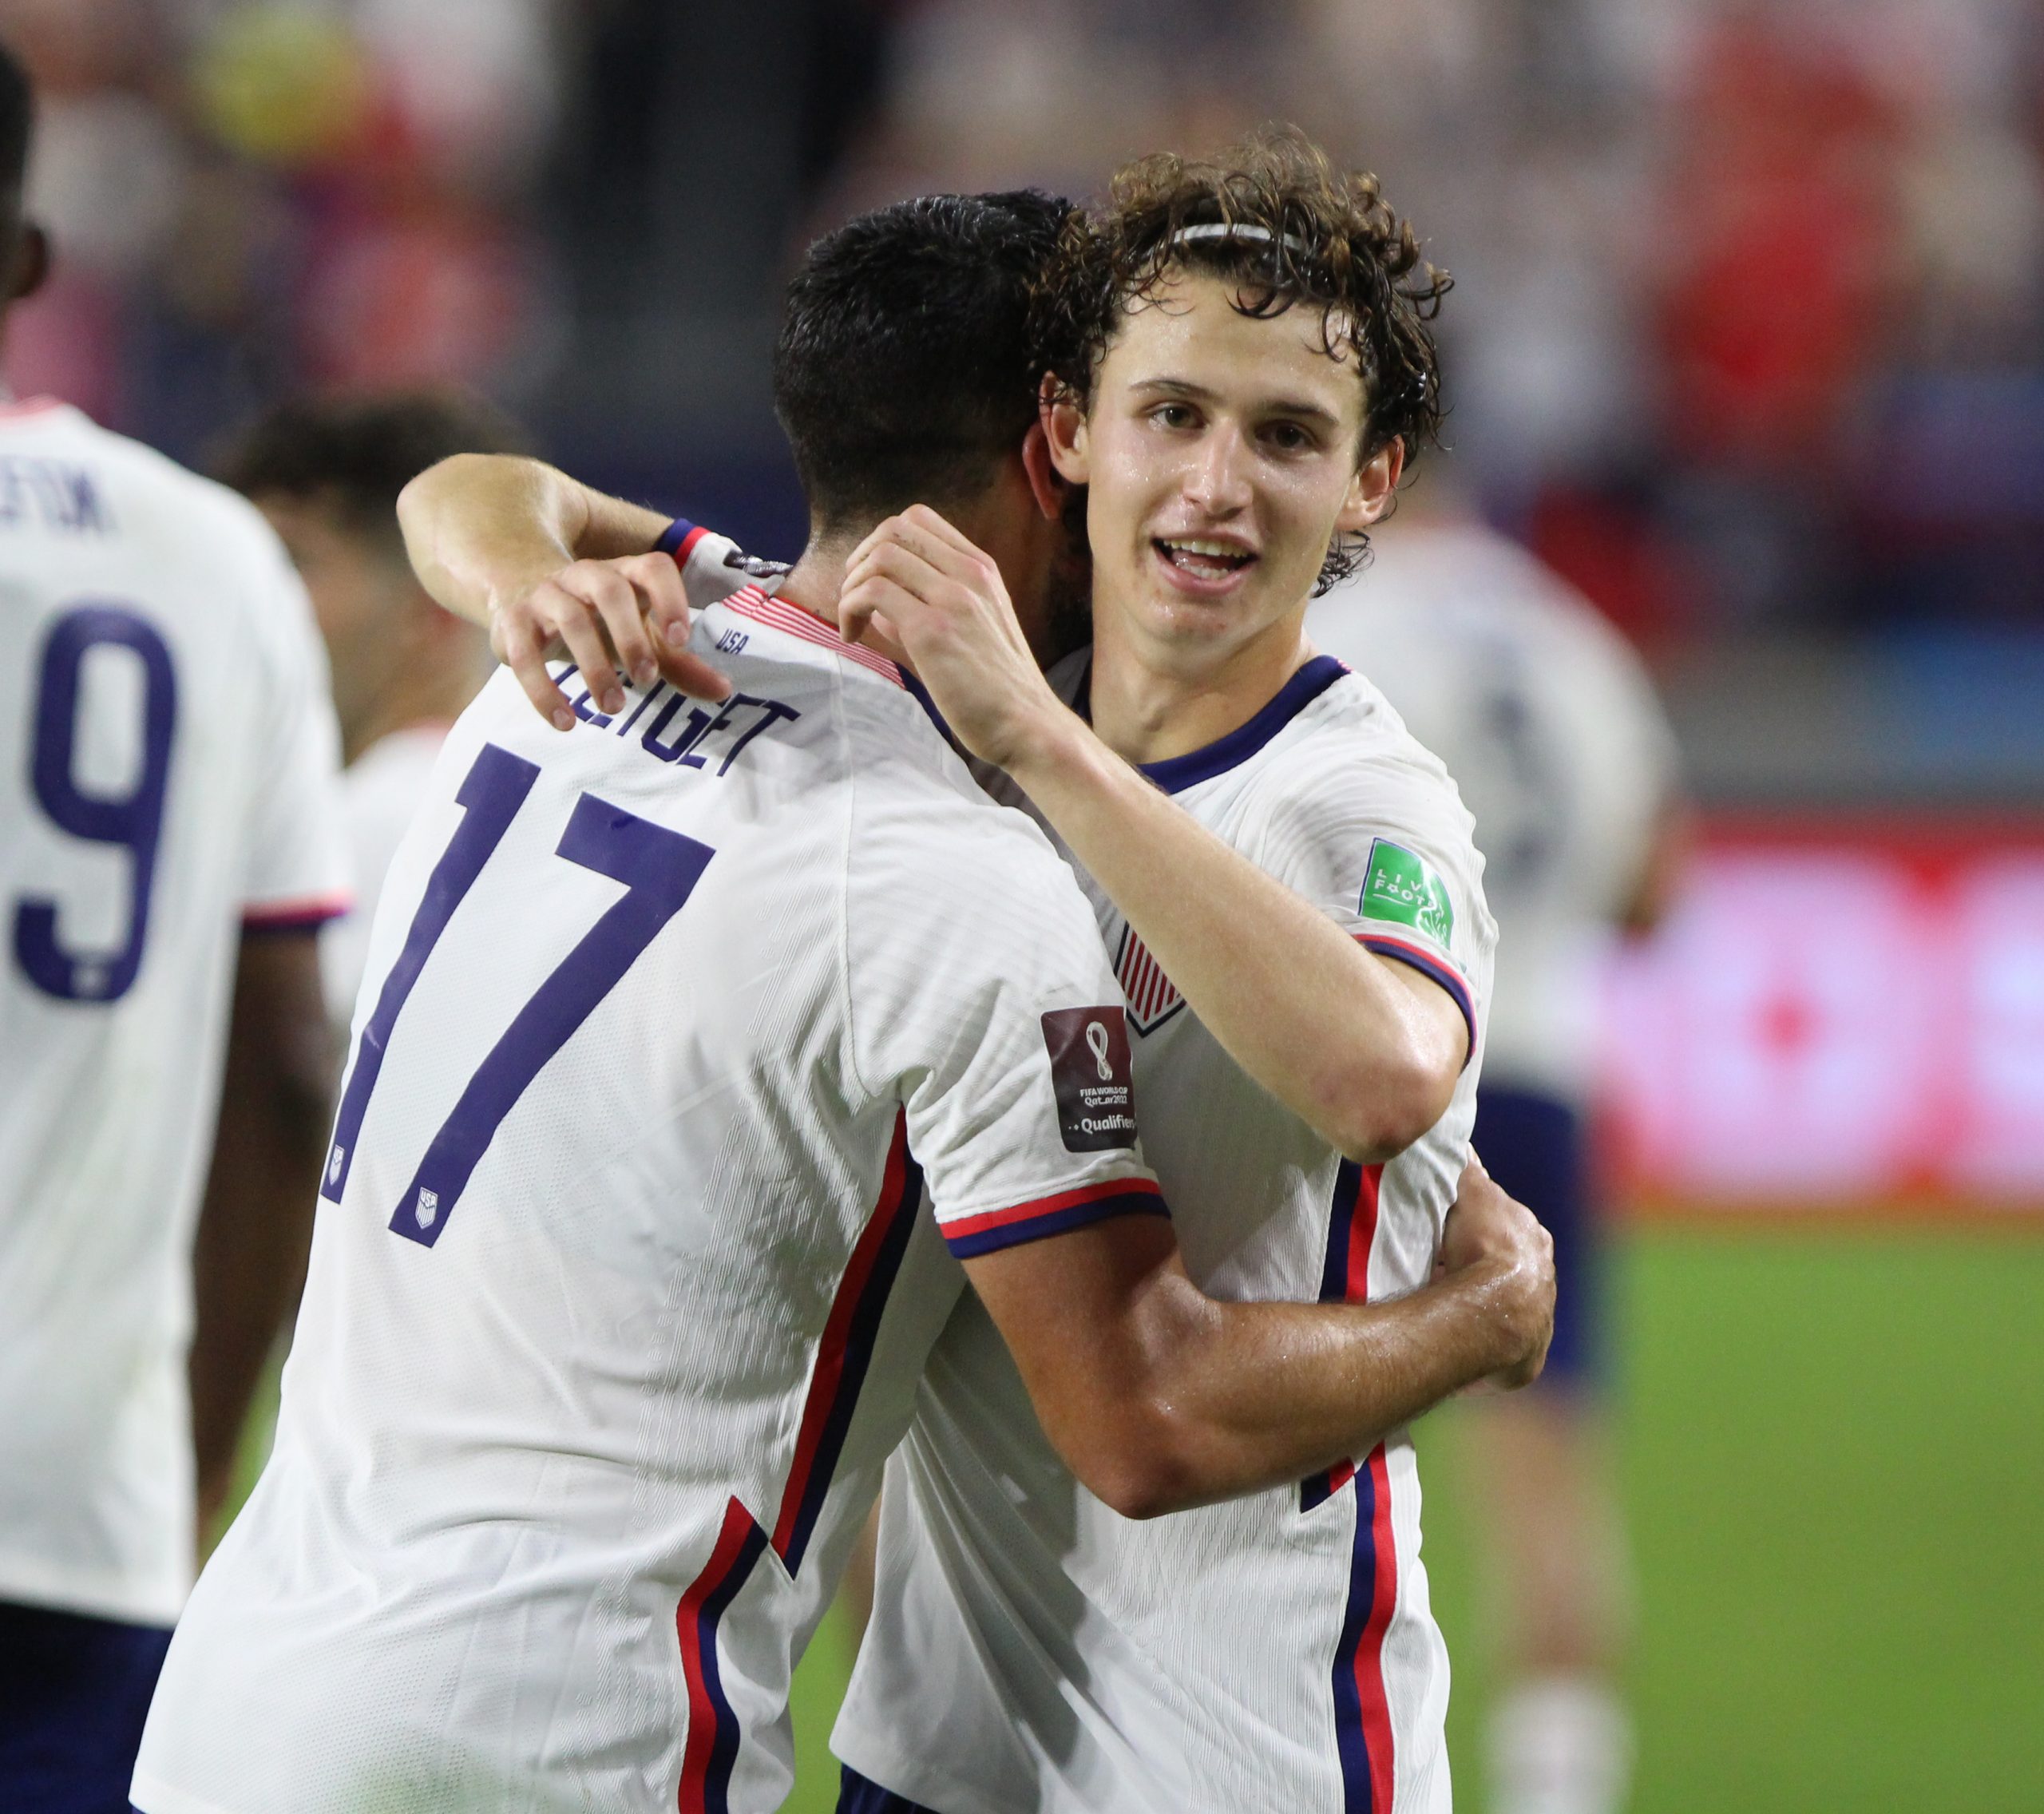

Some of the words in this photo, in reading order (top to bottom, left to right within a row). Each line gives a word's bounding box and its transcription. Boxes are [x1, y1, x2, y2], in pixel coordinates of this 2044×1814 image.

[715, 628, 749, 654] USA
[15, 607, 177, 1003] 9
[320, 742, 715, 1248] 17
[1079, 1087, 1097, 1098] FIFA
[420, 1190, 437, 1208] USA
